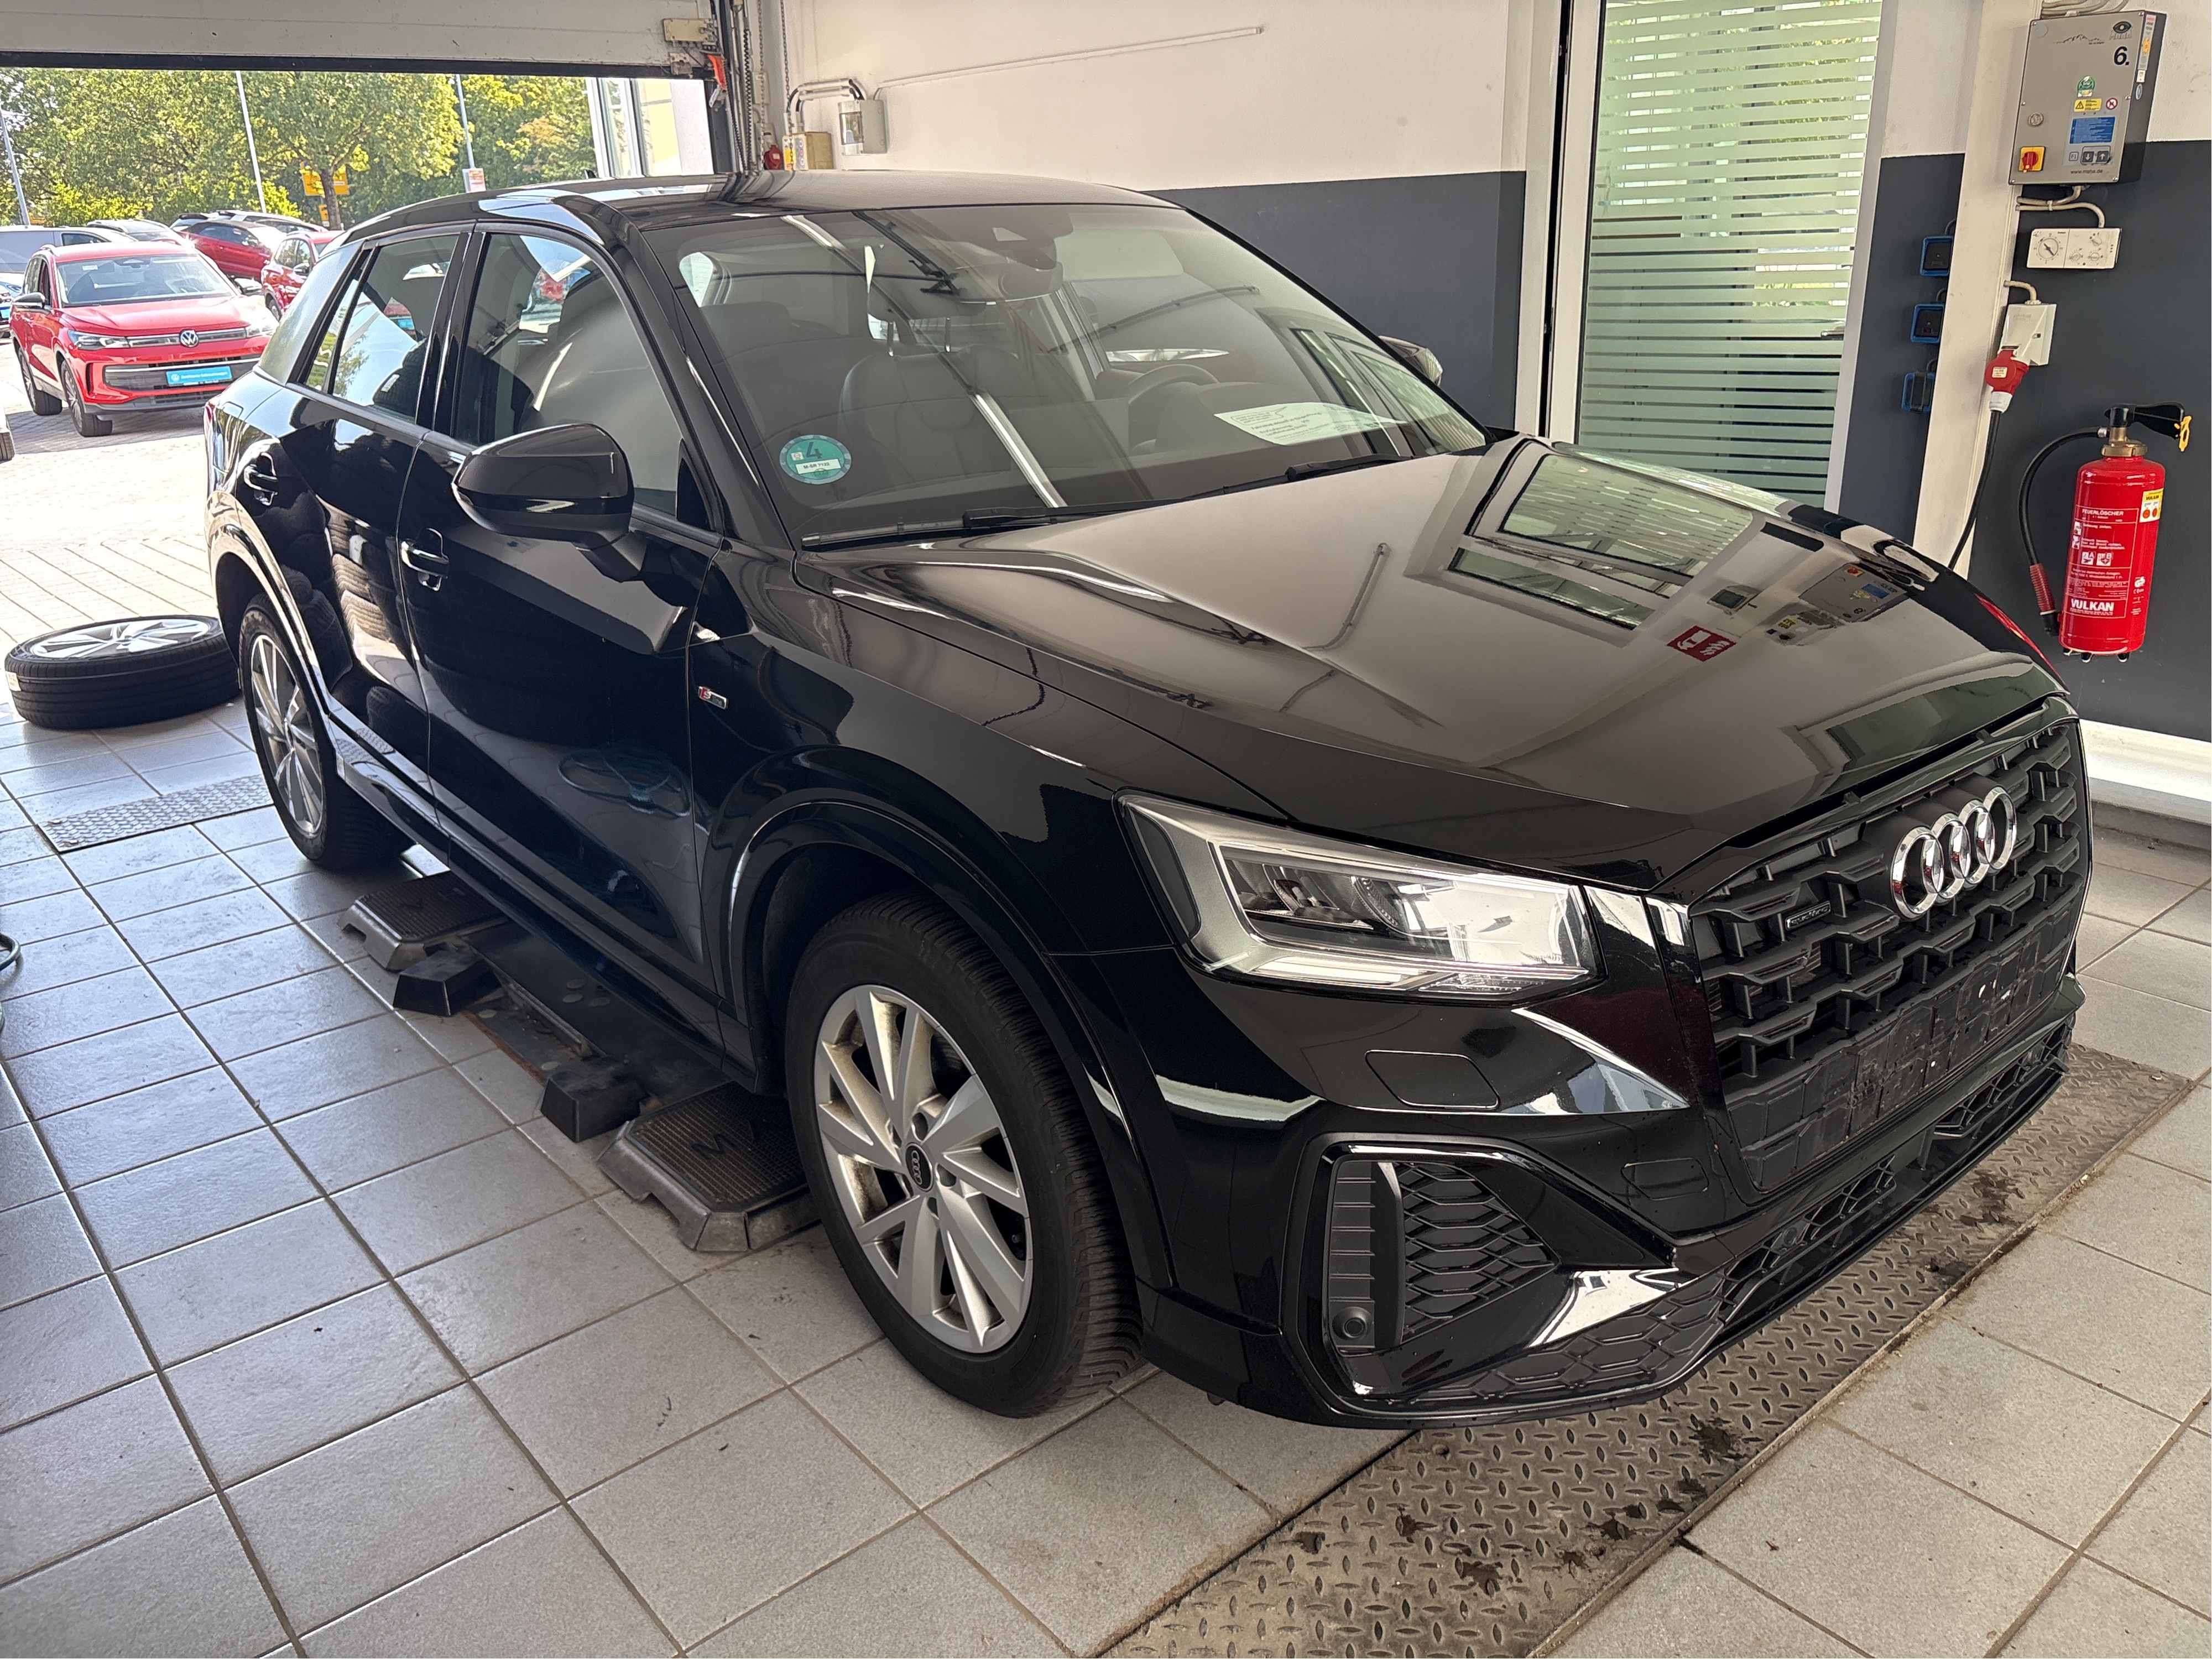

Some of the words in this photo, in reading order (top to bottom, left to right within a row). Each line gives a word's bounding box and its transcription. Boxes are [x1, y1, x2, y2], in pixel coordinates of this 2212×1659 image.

[2114, 46, 2130, 66] 6.
[805, 441, 822, 459] 4
[2070, 598, 2115, 612] VULKAN
